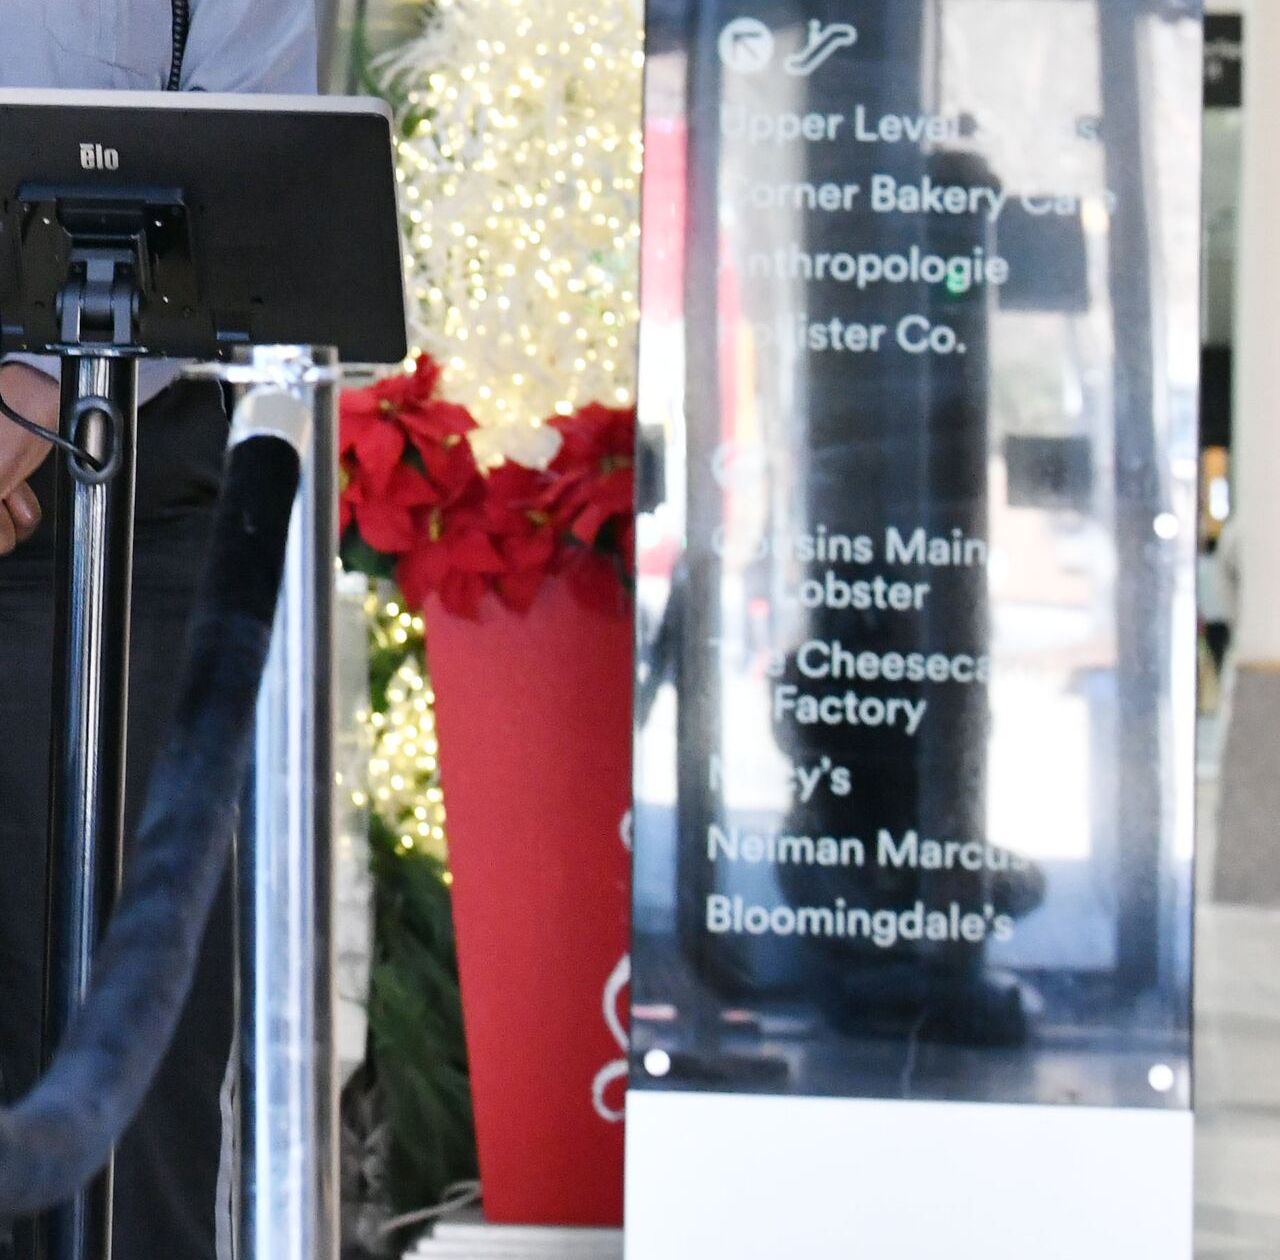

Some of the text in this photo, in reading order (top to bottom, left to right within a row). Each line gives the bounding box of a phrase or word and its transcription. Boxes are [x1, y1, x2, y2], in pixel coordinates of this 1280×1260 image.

[721, 106, 845, 148] Upper
[870, 171, 1005, 221] Bakery
[730, 244, 1010, 294] nthropologie
[894, 312, 968, 355] Co.
[885, 526, 990, 568] Main
[773, 683, 928, 737] Factory
[704, 892, 1015, 948] Bloomingdale's
